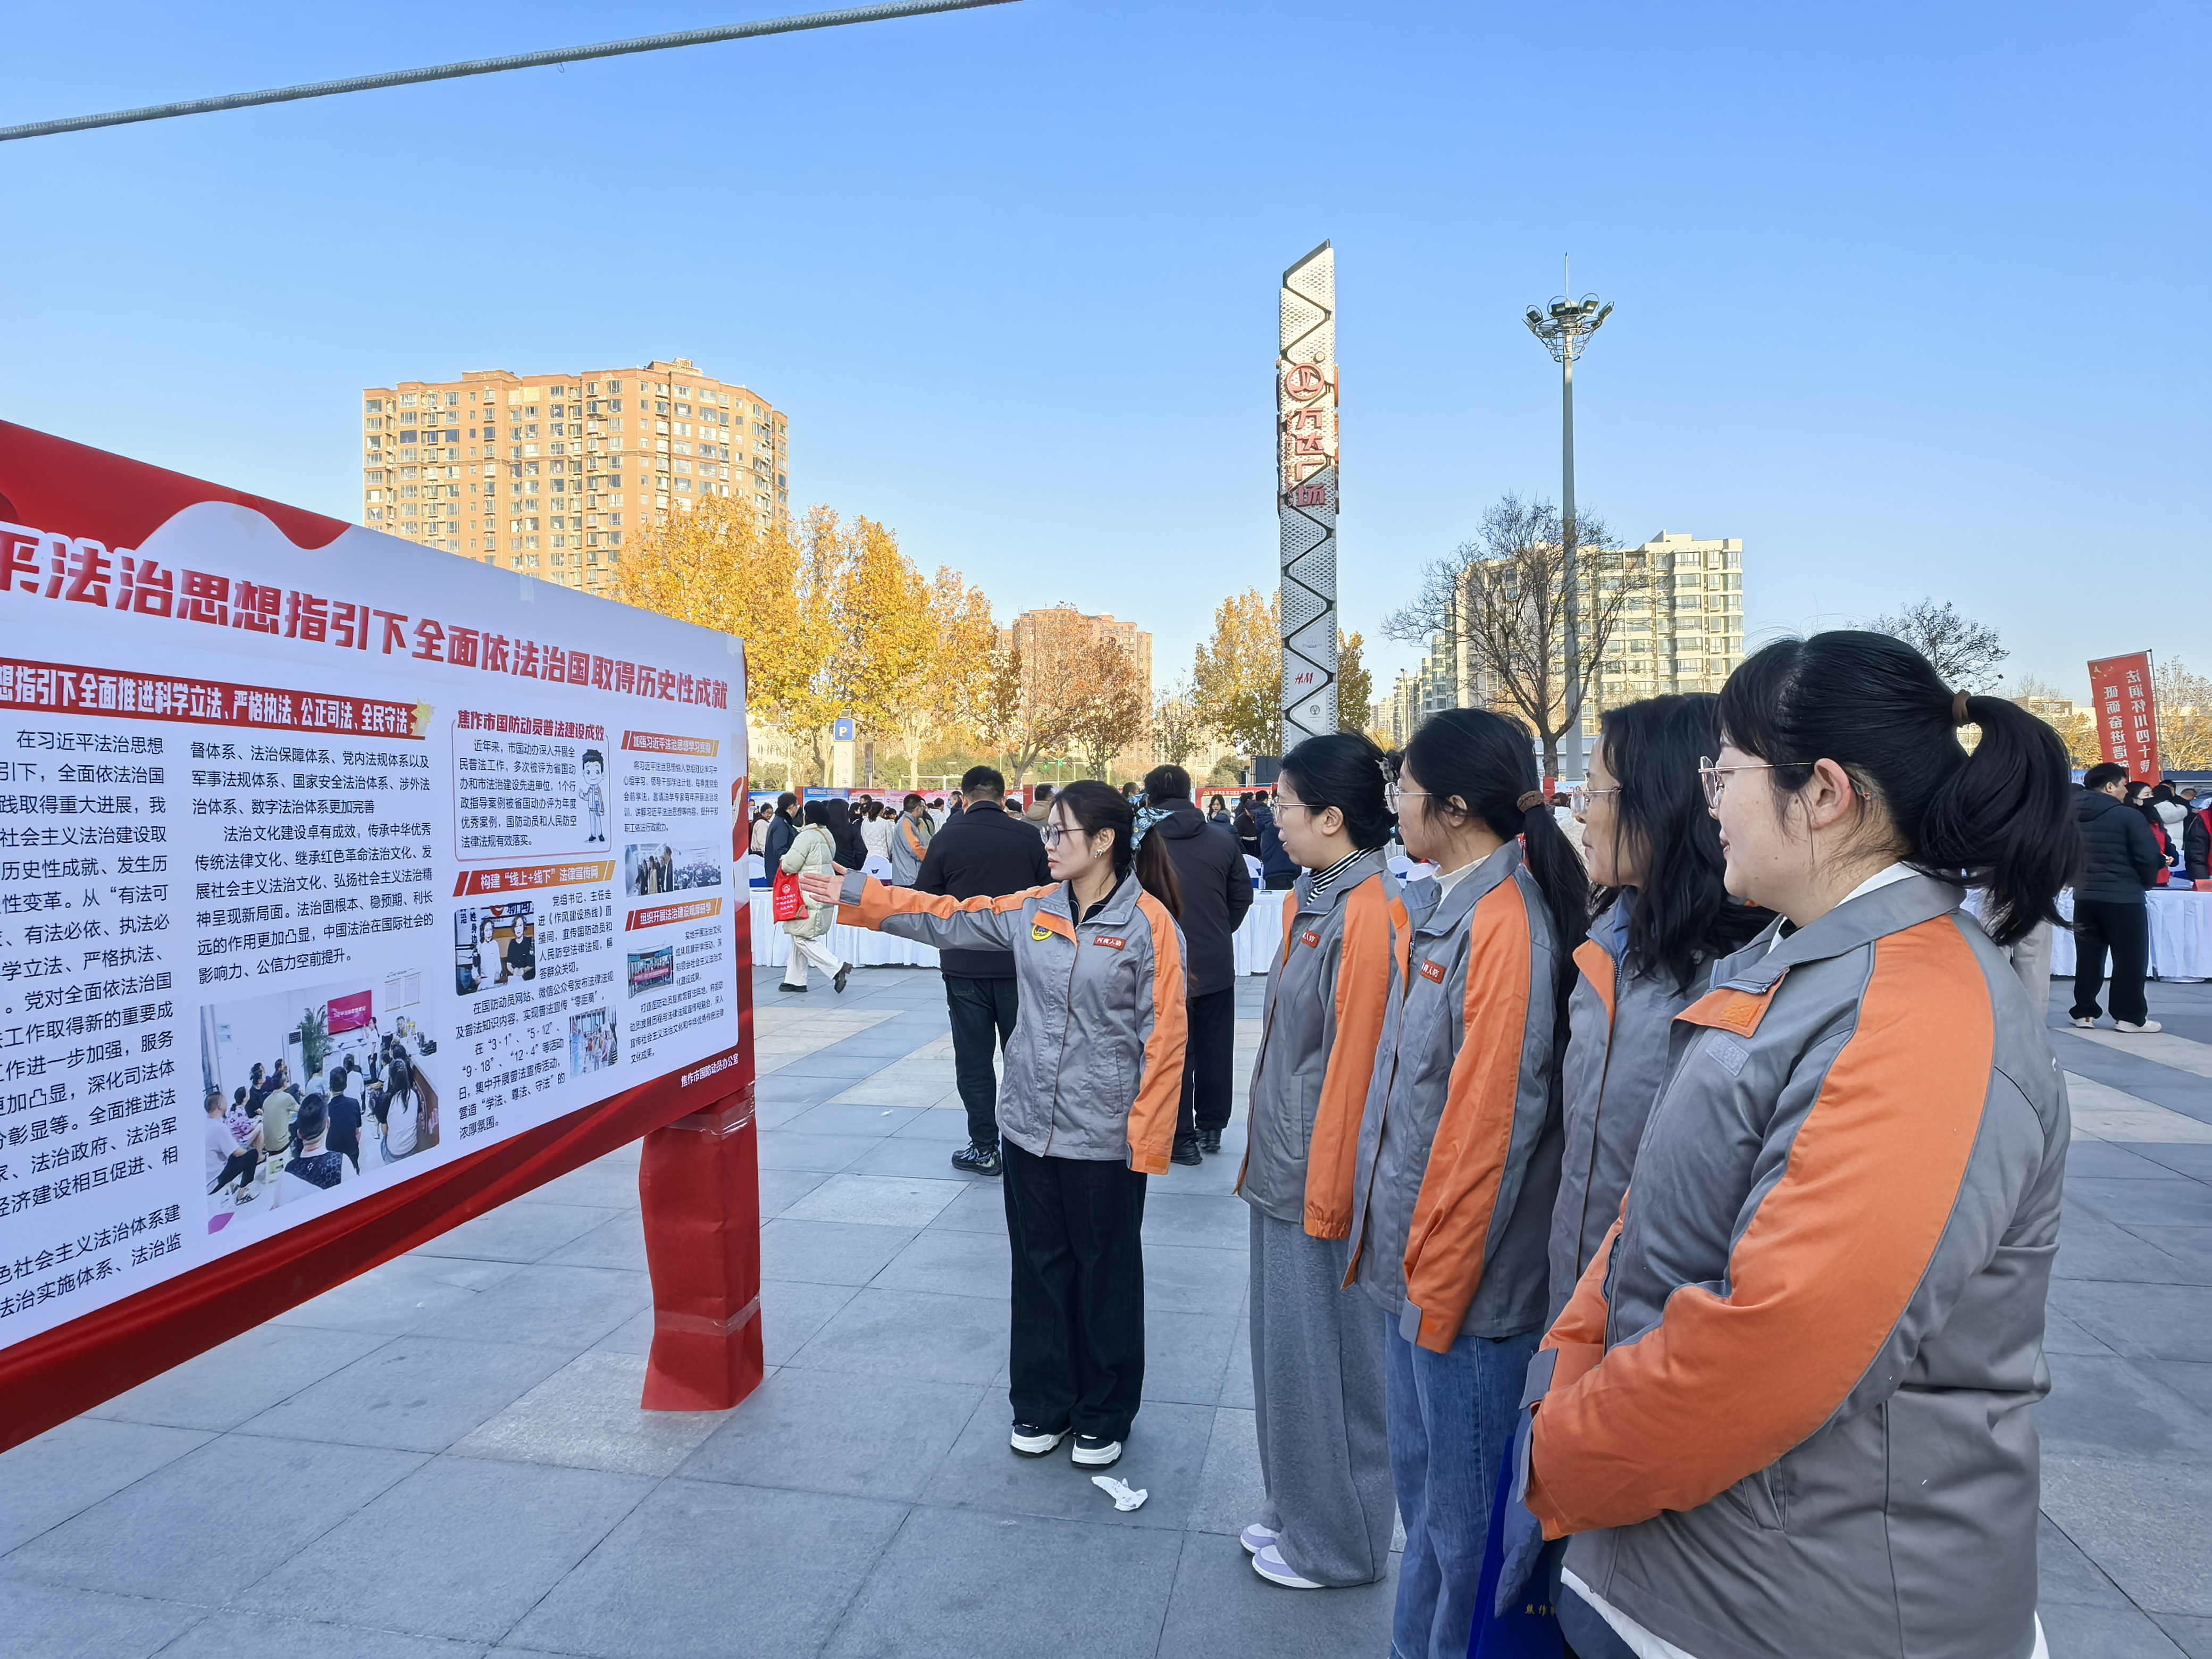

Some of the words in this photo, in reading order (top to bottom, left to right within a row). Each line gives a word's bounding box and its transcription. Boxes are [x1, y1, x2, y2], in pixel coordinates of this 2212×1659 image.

[1294, 407, 1326, 507] 万达广场
[0, 530, 727, 710] 平法治思想指引下全面依法治国取得历史性成就
[457, 710, 605, 741] 焦作市国防动员普法建设成效
[839, 726, 848, 738] P
[16, 730, 164, 755] 在习近平法治思想
[191, 741, 430, 769] 督体系、法治保障体系、党内法规体系以及
[0, 761, 164, 784] 引下，全面依法治国
[192, 769, 430, 791] 军事法规体系、国家安全法治体系、涉外法
[192, 798, 375, 816] 治体系、数字法治体系更加完善
[0, 826, 167, 848] 社会主义法治建设取
[1, 854, 168, 881] 历史性成就、发生历
[0, 883, 169, 915] 性变革。从“有法可
[0, 914, 170, 947] 、有法必依、执法必
[0, 944, 163, 981] 学立法、严格执法、
[198, 948, 352, 985] 影响力、公信力空前提升。
[0, 1001, 173, 1049] 工作取得新的重要成
